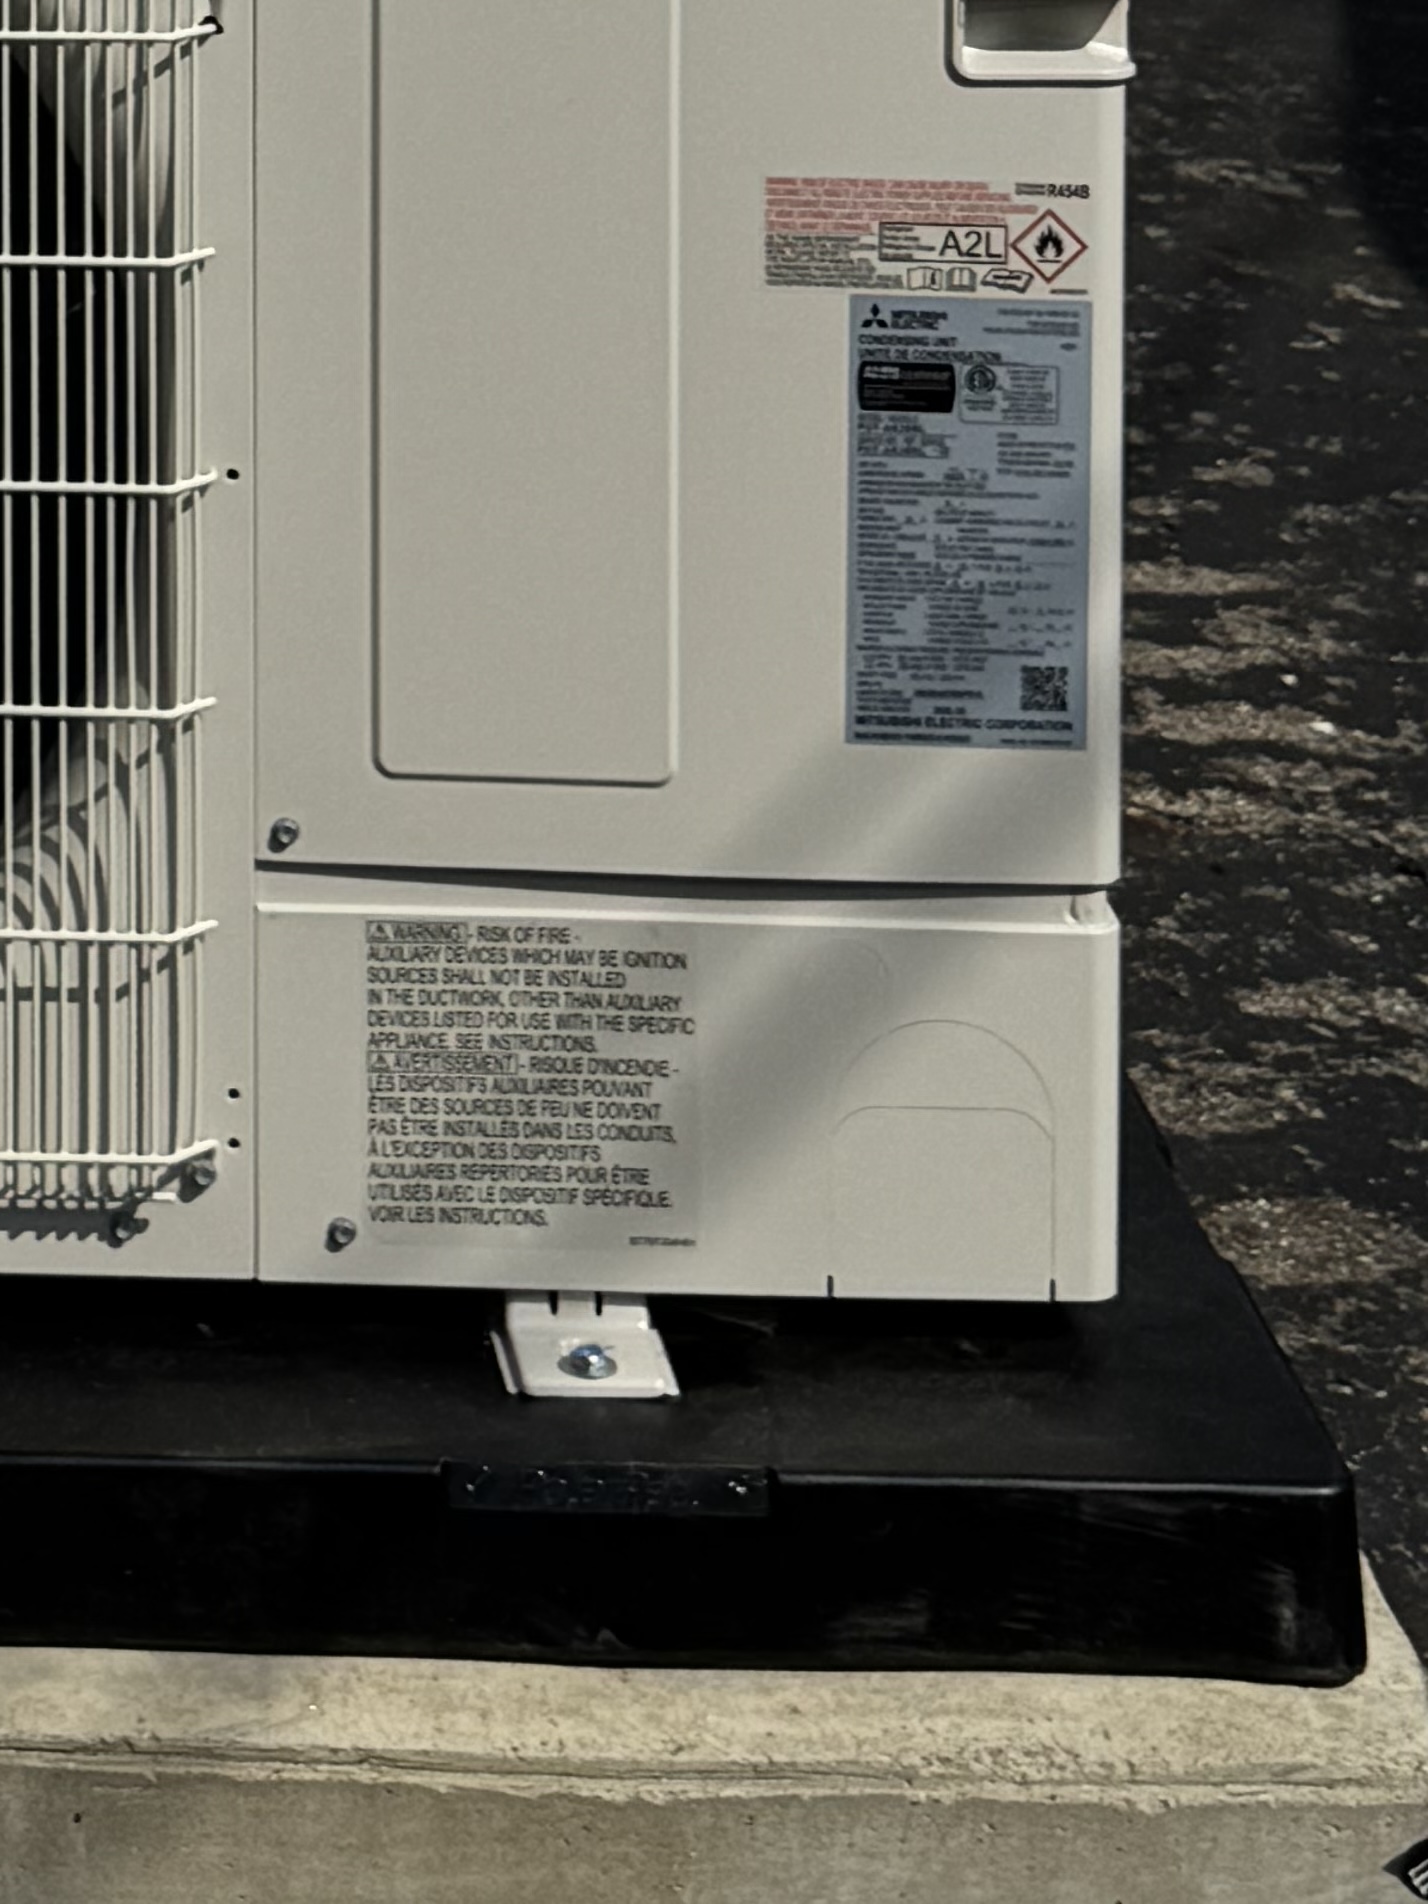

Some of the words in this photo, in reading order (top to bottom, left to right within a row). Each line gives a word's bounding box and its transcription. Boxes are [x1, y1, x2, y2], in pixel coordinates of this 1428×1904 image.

[938, 228, 1004, 259] A2L
[477, 925, 510, 942] RISK
[514, 926, 535, 943] OF
[538, 927, 571, 944] FIRE
[367, 945, 441, 963] AUXILIARY
[445, 946, 508, 964] DEVICES
[512, 947, 560, 965] WHICH
[564, 949, 595, 966] MAY
[599, 950, 619, 968] BE
[622, 950, 688, 969] IGNITION
[367, 966, 438, 984] SOURCES
[442, 967, 486, 985] SHALL
[490, 968, 520, 986] NOT
[524, 969, 543, 987] BE
[548, 970, 627, 988] INSTALLED
[367, 988, 382, 1005] IN
[385, 988, 415, 1005] THE
[508, 990, 560, 1008] OTHER
[563, 991, 603, 1009] THAN
[605, 993, 682, 1011] AUXILIARY
[367, 1009, 430, 1028] DEVICES
[433, 1010, 484, 1028] LISTED
[487, 1011, 518, 1029] FOR
[521, 1012, 551, 1030] USE
[555, 1013, 593, 1031] WITH
[596, 1014, 625, 1033] THE
[628, 1015, 696, 1035] SPECIFIC
[455, 1032, 483, 1050] SEE
[487, 1033, 598, 1053] INSTRUCTIONS.
[529, 1056, 583, 1074] RISQUE
[368, 1074, 395, 1093] LES
[399, 1075, 487, 1094] DISPOSITIFS
[582, 1079, 653, 1098] POUVANT
[368, 1095, 406, 1114] ÊTRE
[410, 1097, 439, 1115] DES
[443, 1098, 514, 1116] SOURCES
[517, 1099, 537, 1117] DE
[541, 1100, 569, 1118] FEU
[573, 1101, 593, 1119] NE
[597, 1102, 661, 1121] DOIVENT
[368, 1118, 396, 1135] PAS
[401, 1116, 438, 1136] ÊTRE
[523, 1121, 562, 1139] DANS
[566, 1123, 593, 1140] LES
[597, 1124, 677, 1144] CONDUITS,
[478, 1141, 508, 1160] DES
[511, 1143, 601, 1163] DISPOSITIFS
[566, 1165, 607, 1184] POUR
[611, 1164, 650, 1186] ÊTRE
[435, 1185, 474, 1203] AVEC
[477, 1186, 496, 1203] LE
[499, 1186, 579, 1205] DISPOSITIF
[368, 1205, 405, 1223] VOIR
[407, 1206, 435, 1224] LES
[438, 1207, 549, 1227] INSTRUCTIONS.
